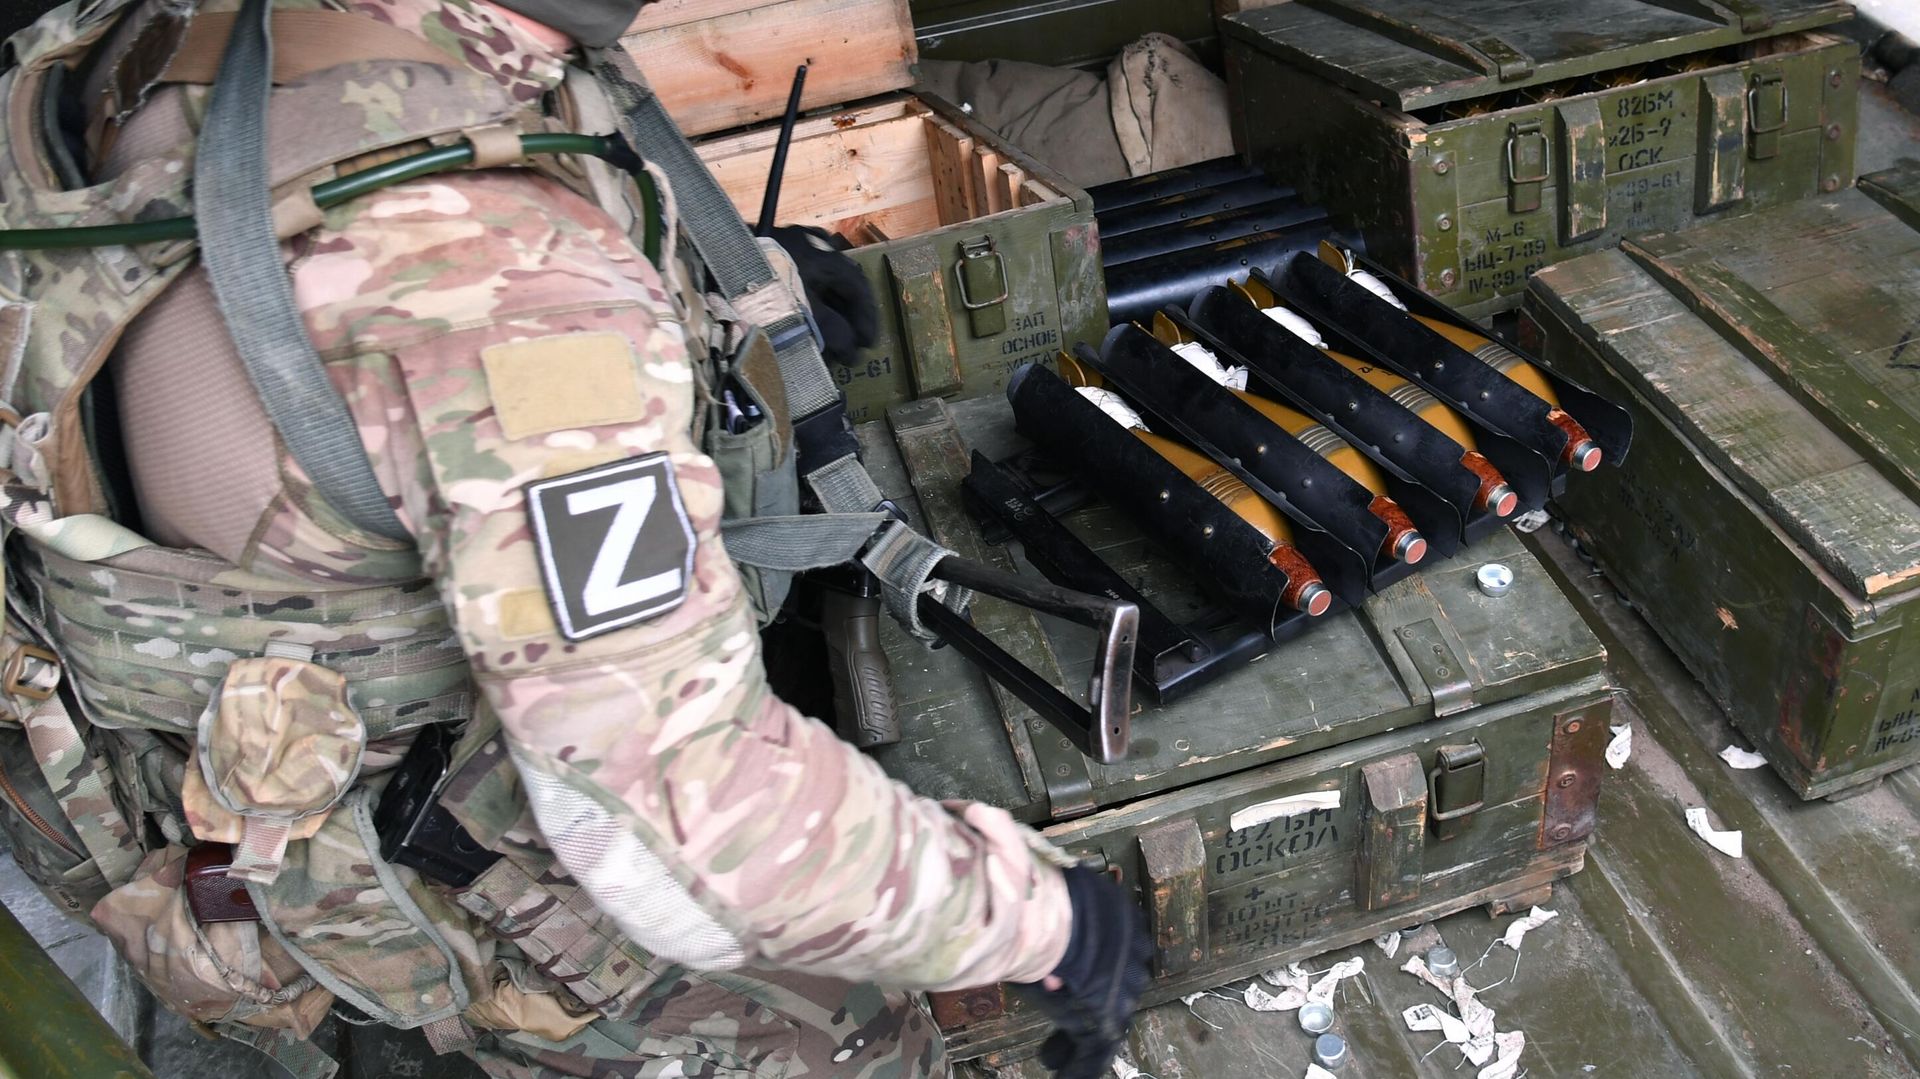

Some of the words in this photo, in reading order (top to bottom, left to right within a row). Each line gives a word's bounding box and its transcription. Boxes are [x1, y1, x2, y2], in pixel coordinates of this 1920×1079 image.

[1617, 90, 1673, 117] 82БМ
[1002, 329, 1057, 354] ОСНОВ
[566, 475, 682, 616] Z
[1216, 825, 1339, 874] ОСКОЛ
